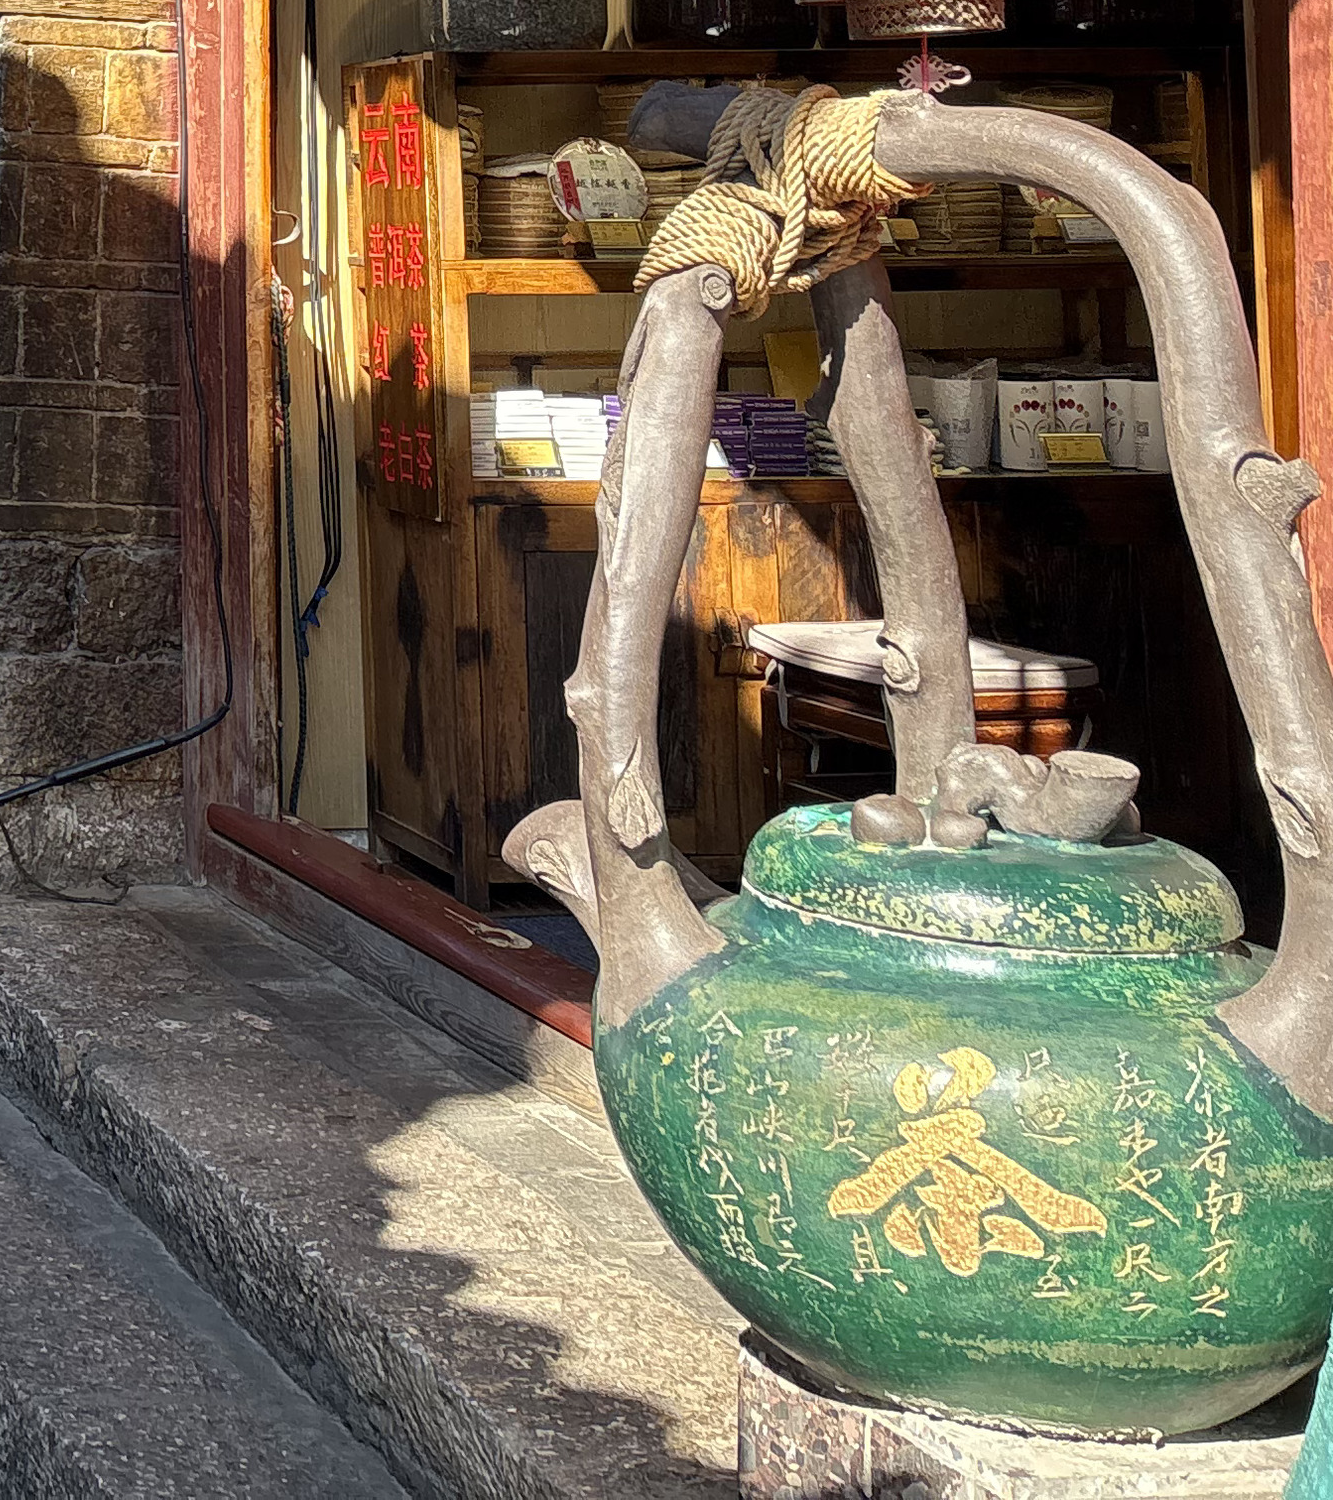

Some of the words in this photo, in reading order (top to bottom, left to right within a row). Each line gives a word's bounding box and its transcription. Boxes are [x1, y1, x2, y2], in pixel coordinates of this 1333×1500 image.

[362, 91, 423, 191] 云南
[368, 222, 425, 291] 普洱茶
[379, 419, 433, 490] 老白茶
[827, 1046, 1108, 1277] 茶
